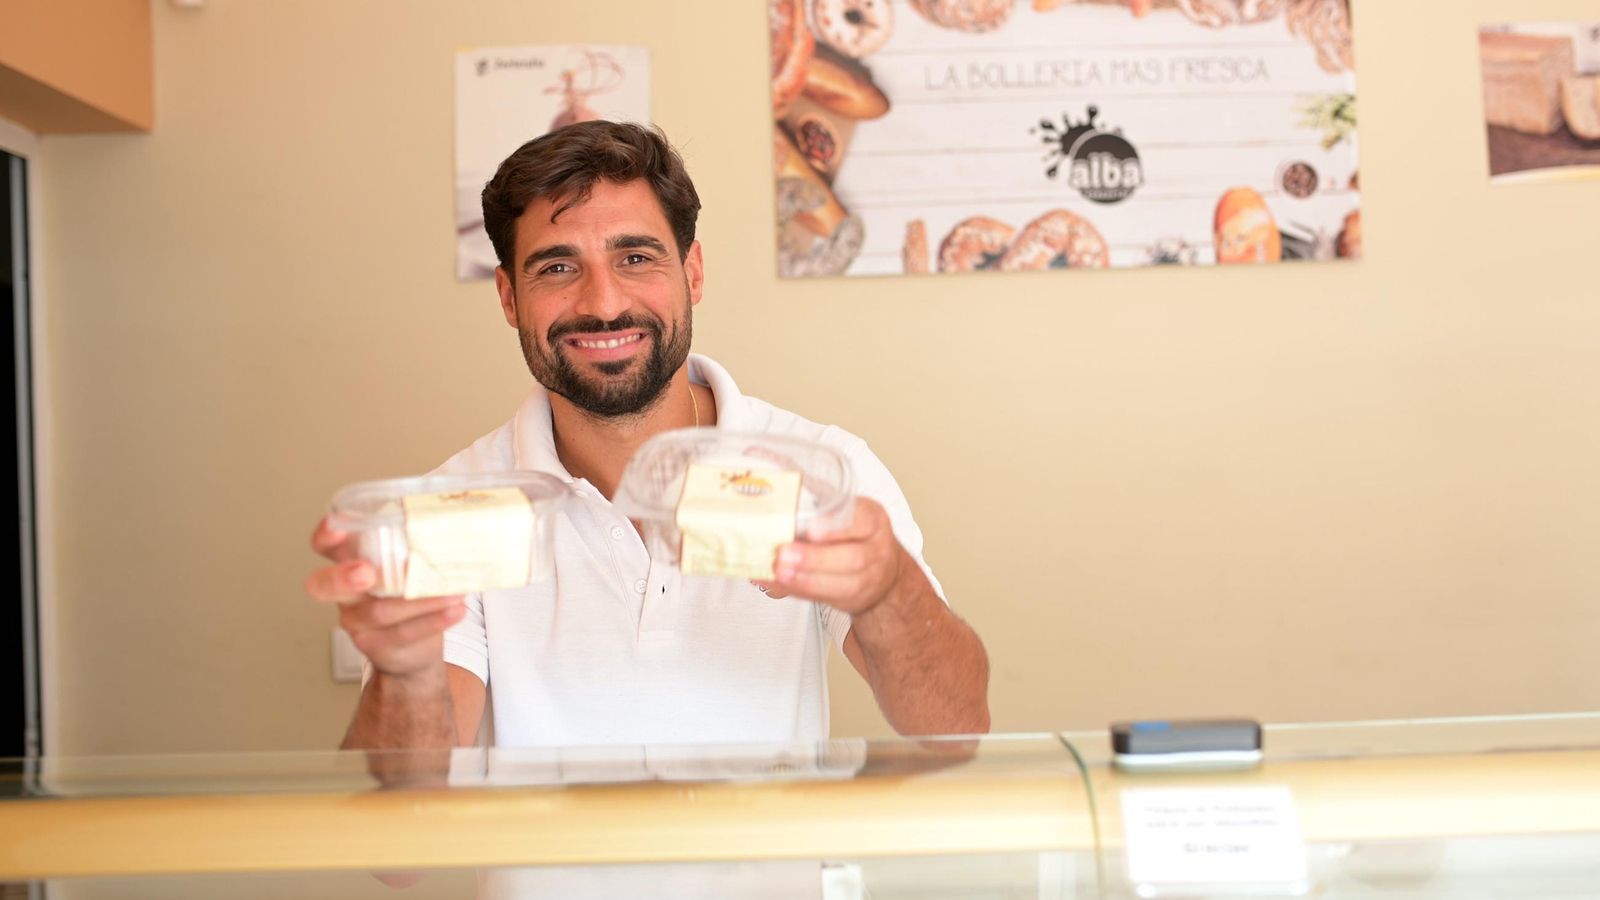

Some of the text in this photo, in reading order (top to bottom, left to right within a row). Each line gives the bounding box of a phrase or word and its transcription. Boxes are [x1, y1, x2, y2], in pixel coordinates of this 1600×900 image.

[924, 64, 960, 90] LA
[1109, 58, 1164, 86] MAS
[1169, 55, 1271, 84] FRESCA
[1071, 153, 1142, 188] alba
